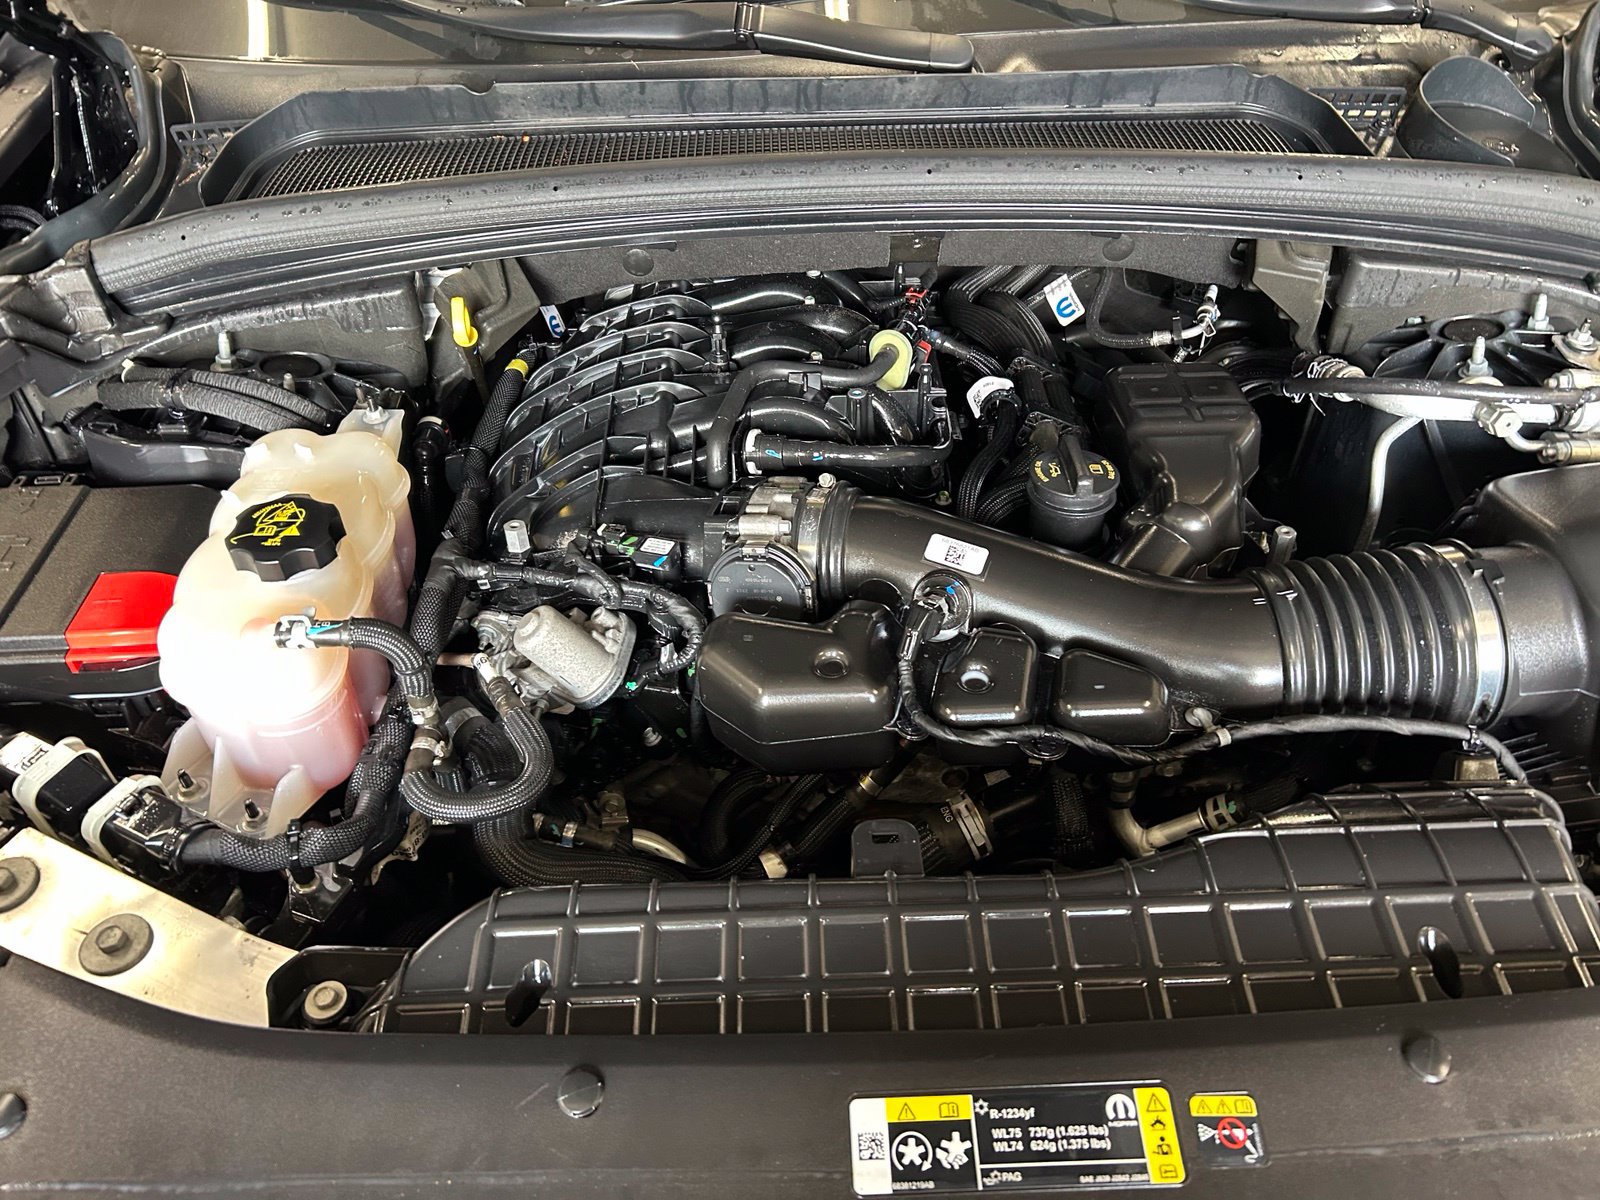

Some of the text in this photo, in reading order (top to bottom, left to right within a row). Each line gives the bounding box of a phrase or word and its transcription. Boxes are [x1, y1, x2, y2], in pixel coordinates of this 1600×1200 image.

[940, 805, 954, 823] ENG
[989, 1107, 1036, 1121] R-1234yf
[991, 1124, 1110, 1140] WL75 737g (1.625 lbs)
[992, 1137, 1112, 1152] WL74 624g (1.375 lbs)
[1001, 1171, 1023, 1183] PAG
